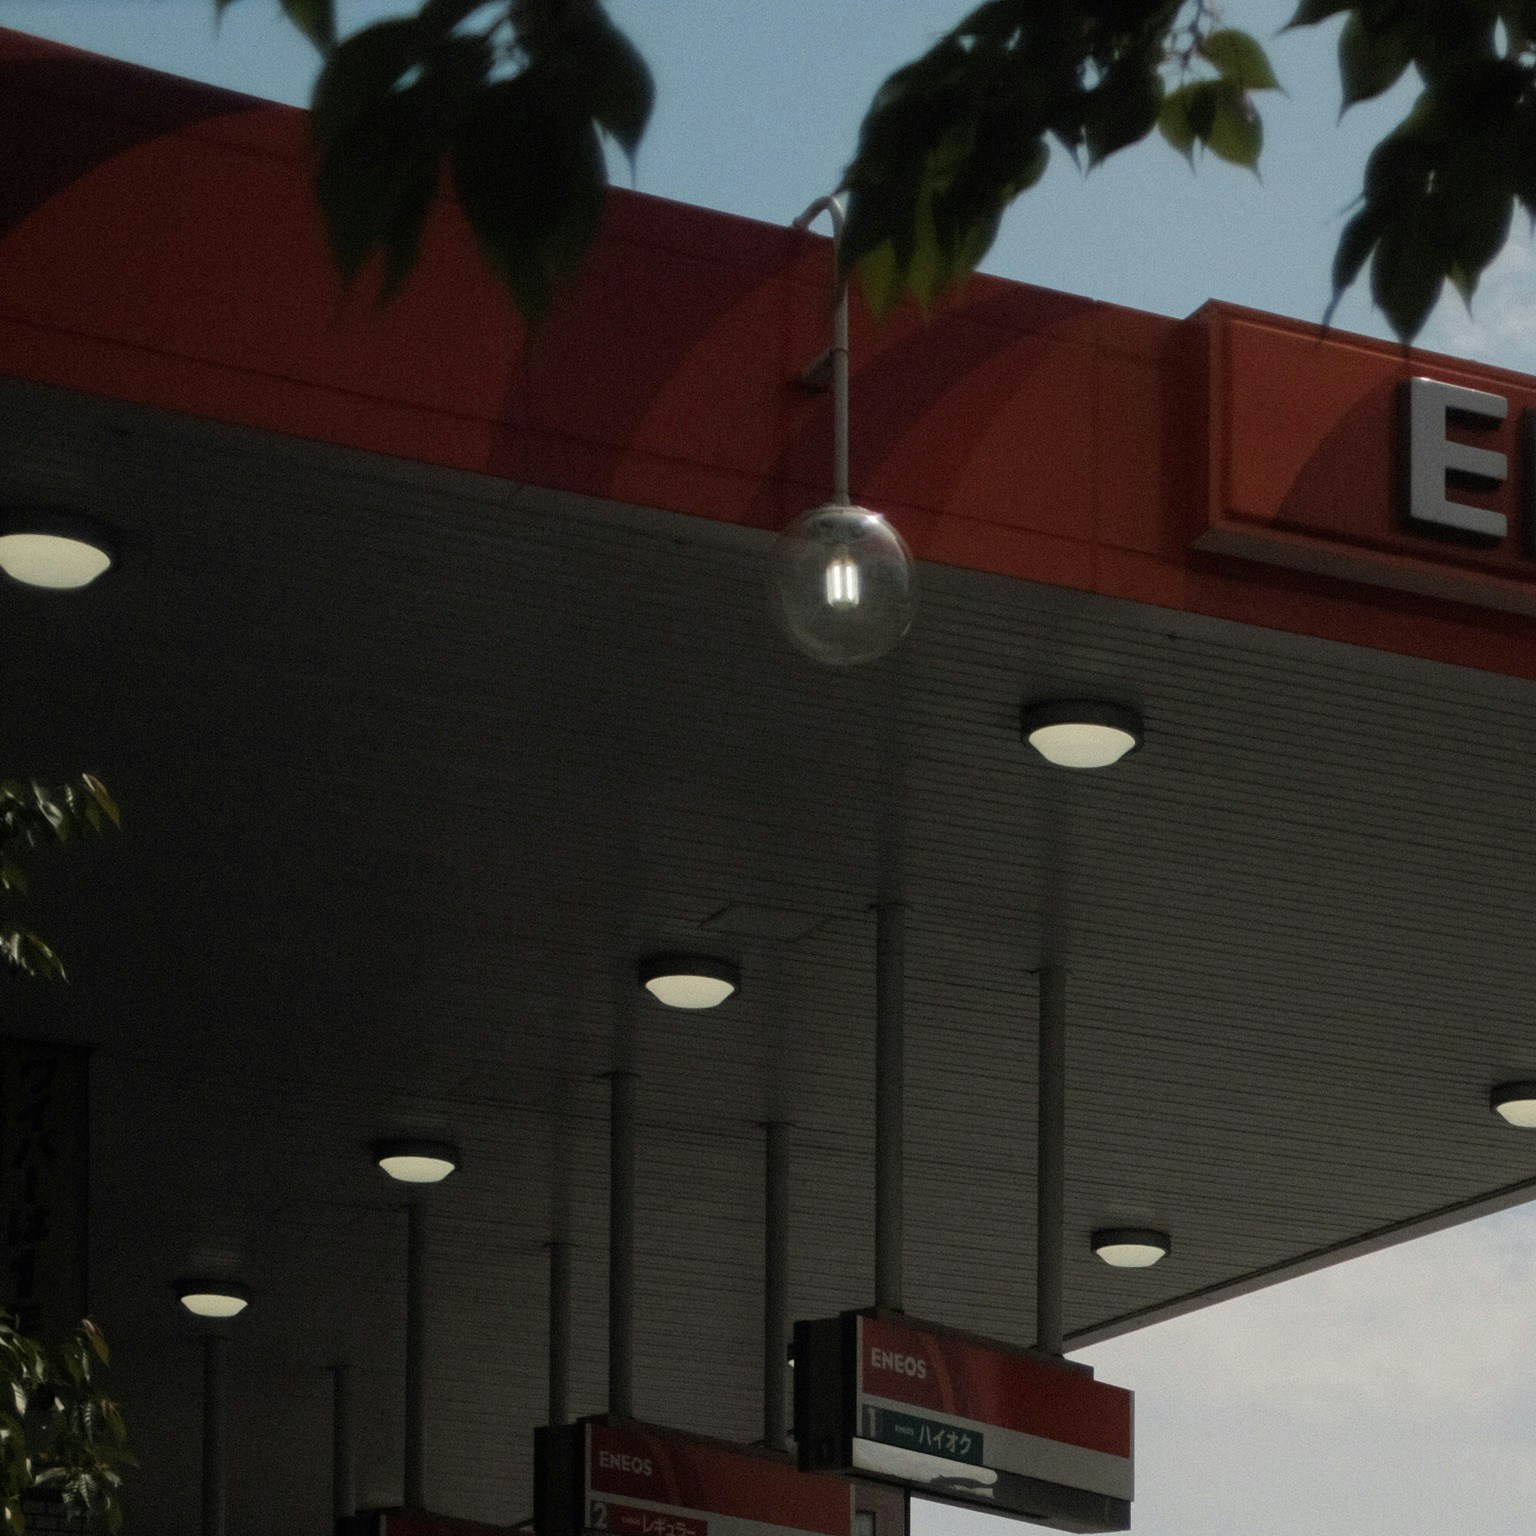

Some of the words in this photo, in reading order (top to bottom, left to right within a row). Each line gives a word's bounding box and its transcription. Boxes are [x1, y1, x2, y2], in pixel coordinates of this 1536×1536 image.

[871, 1347, 927, 1379] ENEOS
[919, 1424, 972, 1455] ハイオク
[598, 1450, 653, 1477] ENEOS
[593, 1502, 608, 1529] 2
